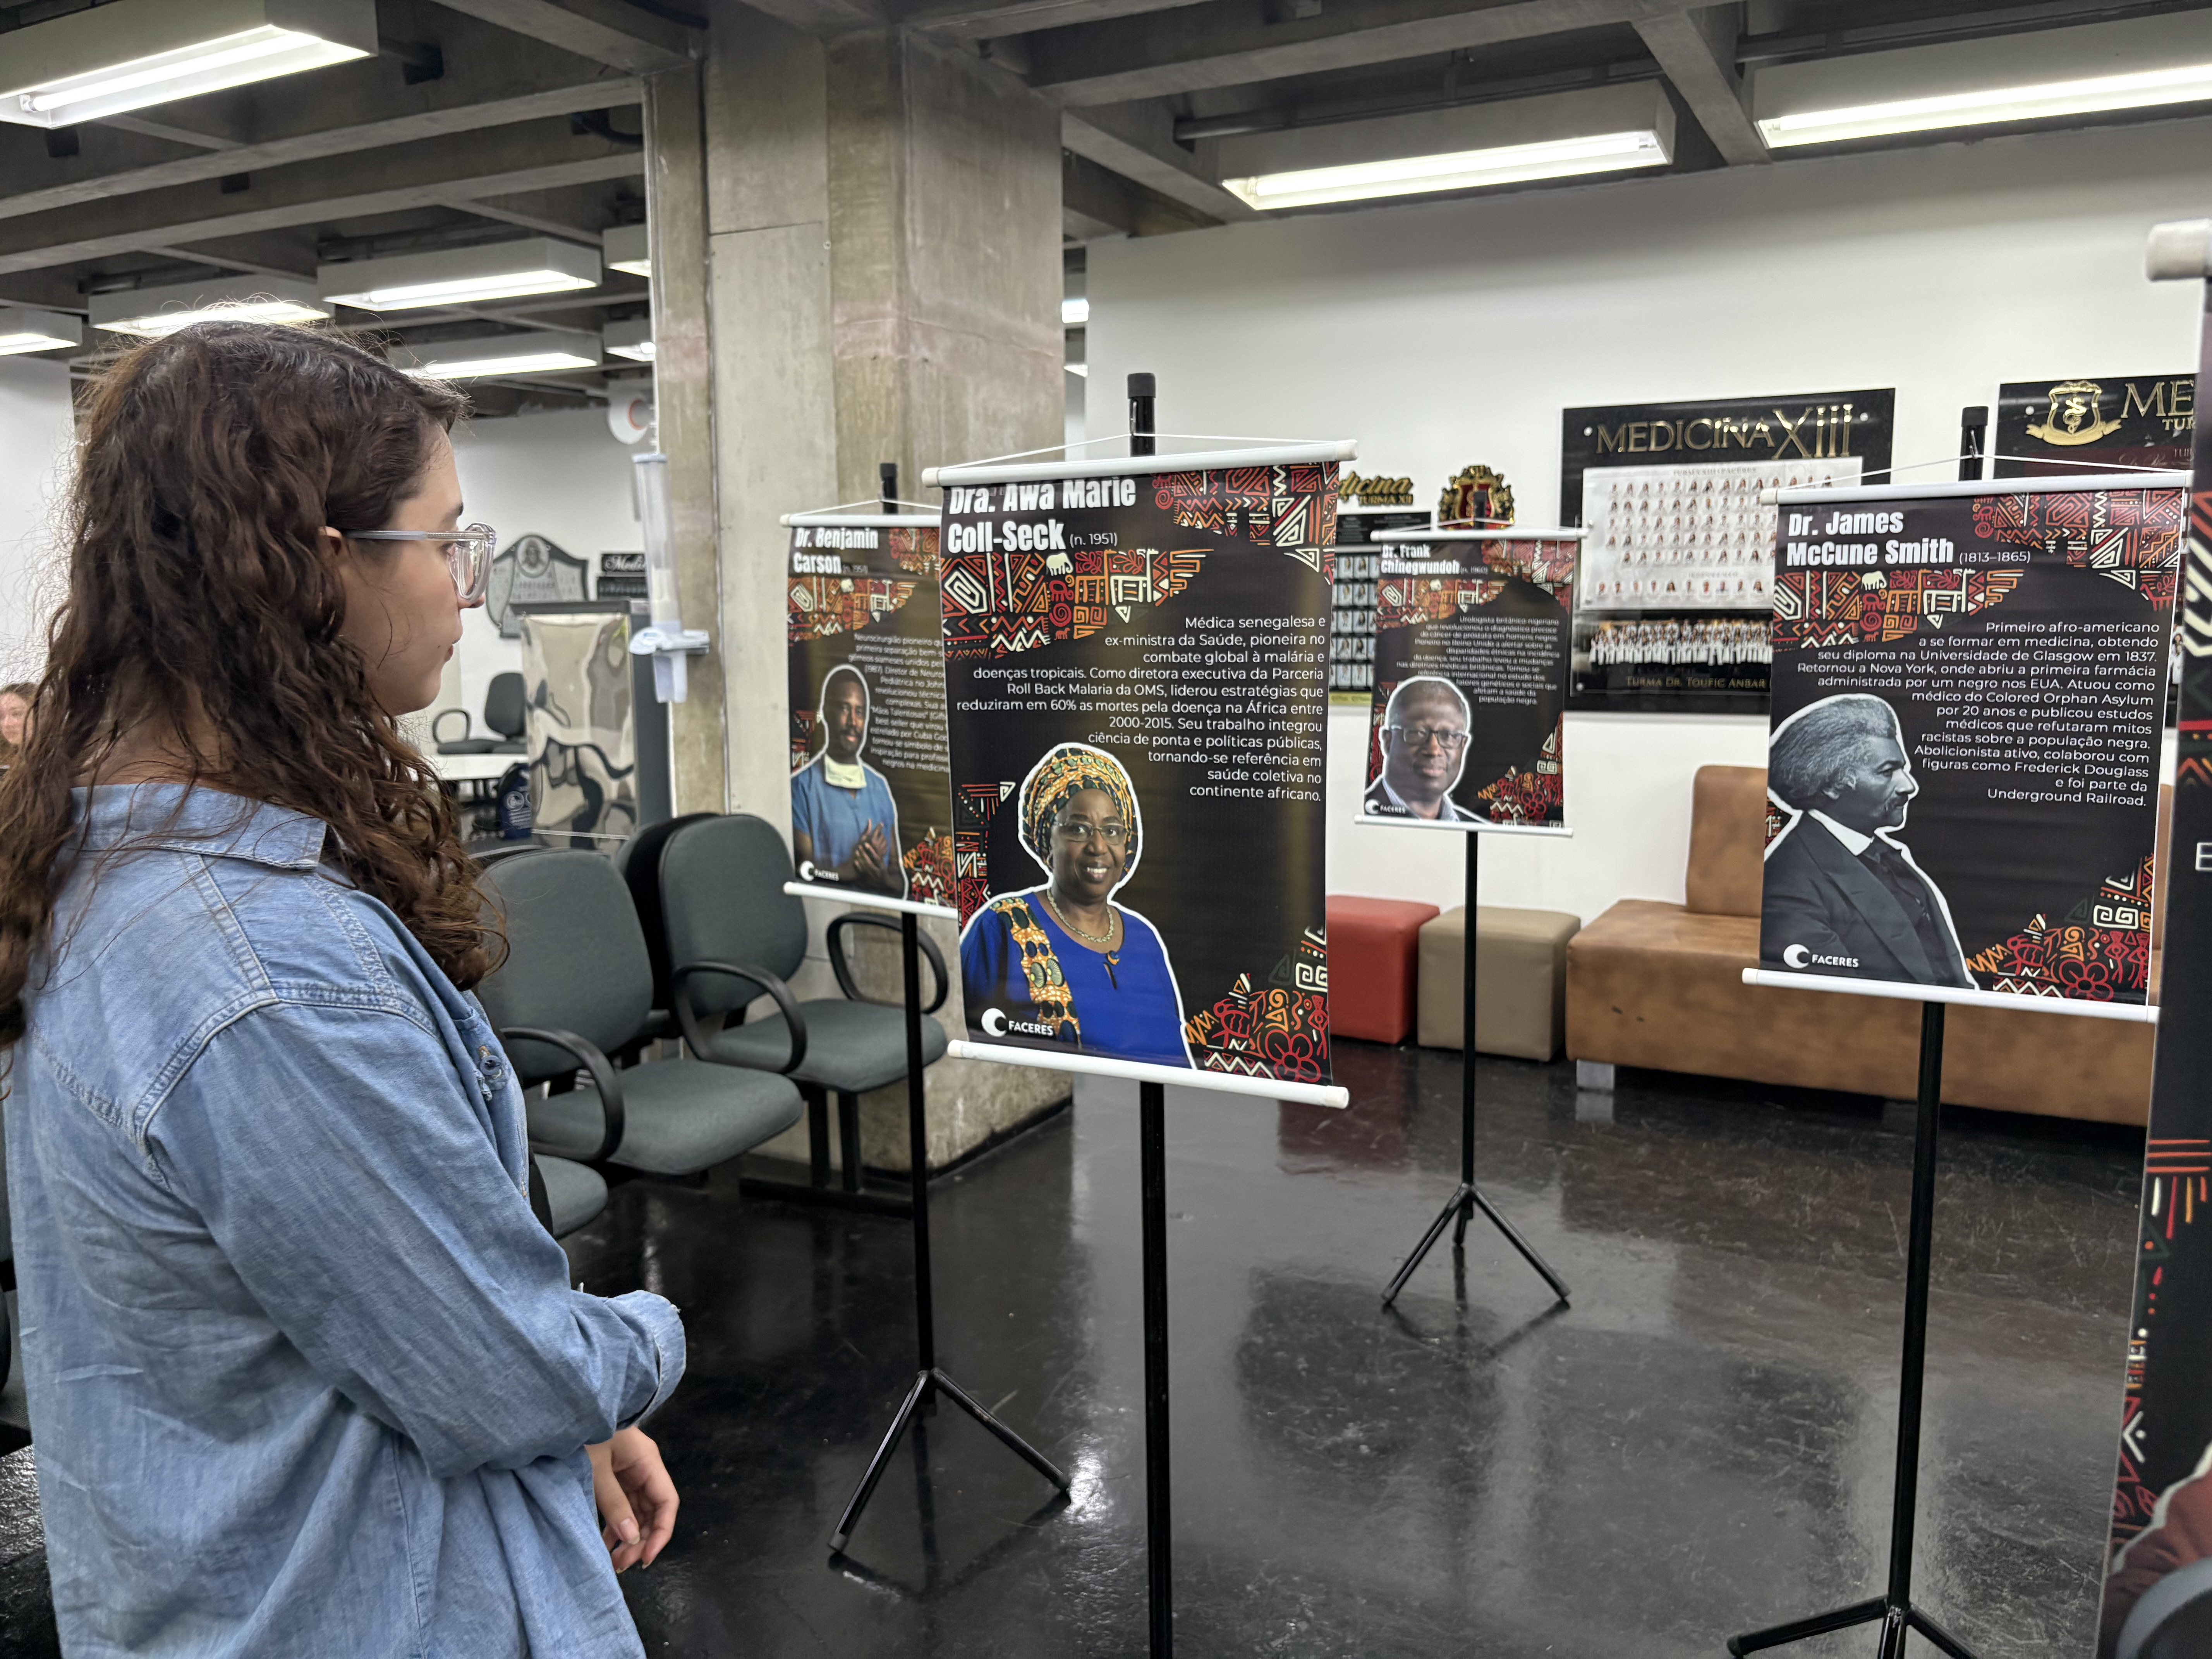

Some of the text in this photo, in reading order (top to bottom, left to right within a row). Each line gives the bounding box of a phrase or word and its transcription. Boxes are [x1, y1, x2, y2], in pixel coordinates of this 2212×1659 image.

[949, 477, 1136, 514] Dra. Awa Marie
[1358, 494, 1396, 505] TURMA
[1788, 511, 1904, 536] Dr. James
[795, 527, 878, 550] Dr. Benjamin
[948, 519, 1117, 553] Coll-Seck (n. 1951)
[1382, 543, 1431, 558] Dr. Frank
[1786, 541, 1878, 566] McCune
[1885, 538, 1954, 565] Smith
[793, 551, 842, 574] Carson
[1185, 615, 1326, 631] Médica senegalesa e
[1986, 621, 2160, 633] Primeiro afro-americano
[1105, 632, 1325, 648] ex-ministra da Saúde, pioneira no
[1919, 635, 2159, 649] a se formar em medicina, obtendo
[1143, 649, 1324, 666] combate global à malária e
[1818, 649, 2157, 663] seu diploma na Universidade de Glasgow em 1837.
[973, 666, 1323, 681] doenças tropicais. Como diretora executiva da Parceria
[1798, 663, 2156, 677] Retornou a Nova York, onde abriu a primeira farmácia
[1007, 682, 1031, 694] Roll
[1034, 682, 1066, 695] Back
[1069, 683, 1113, 695] Malaria
[1115, 683, 1131, 696] da
[1134, 684, 1168, 698] OMS,
[1171, 684, 1218, 697] liderou
[1221, 684, 1298, 700] estratégias
[1300, 687, 1323, 700] que
[1627, 676, 1662, 688] TURMA
[1686, 677, 1726, 688] TOUFIC
[1728, 678, 1767, 689] ANBAR
[1817, 675, 2155, 691] administrada por um negro nos EUA. Atuou como
[957, 698, 1323, 716] reduziram em 60% as mortes pela doença na África entre
[1912, 690, 2154, 707] médico do Colored Orphan Asylum
[1937, 705, 2153, 720] por 20 anos e publicou estudos
[1109, 716, 1323, 734] 2000-2015. Seu trabalho integrou
[1946, 718, 2152, 735] médicos que refutaram mitos
[1088, 731, 1322, 752] ciência de ponta e políticas públicas,
[1922, 731, 2150, 750] racistas sobre a população negra.
[1148, 750, 1322, 767] tornando-se referência em
[1914, 744, 2149, 764] Abolicionista ativo, colaborou com
[1207, 768, 1322, 784] saúde coletiva no
[1922, 757, 2149, 778] figuras como Frederick Douglass
[1189, 784, 1321, 802] continente africano.
[2055, 777, 2147, 792] e foi parte da
[1988, 788, 2146, 807] Underground Railroad.
[1380, 805, 1406, 814] FACERES
[814, 869, 839, 882] FACERES
[1812, 954, 1859, 968] FACERES
[1009, 1020, 1054, 1037] FACERES
